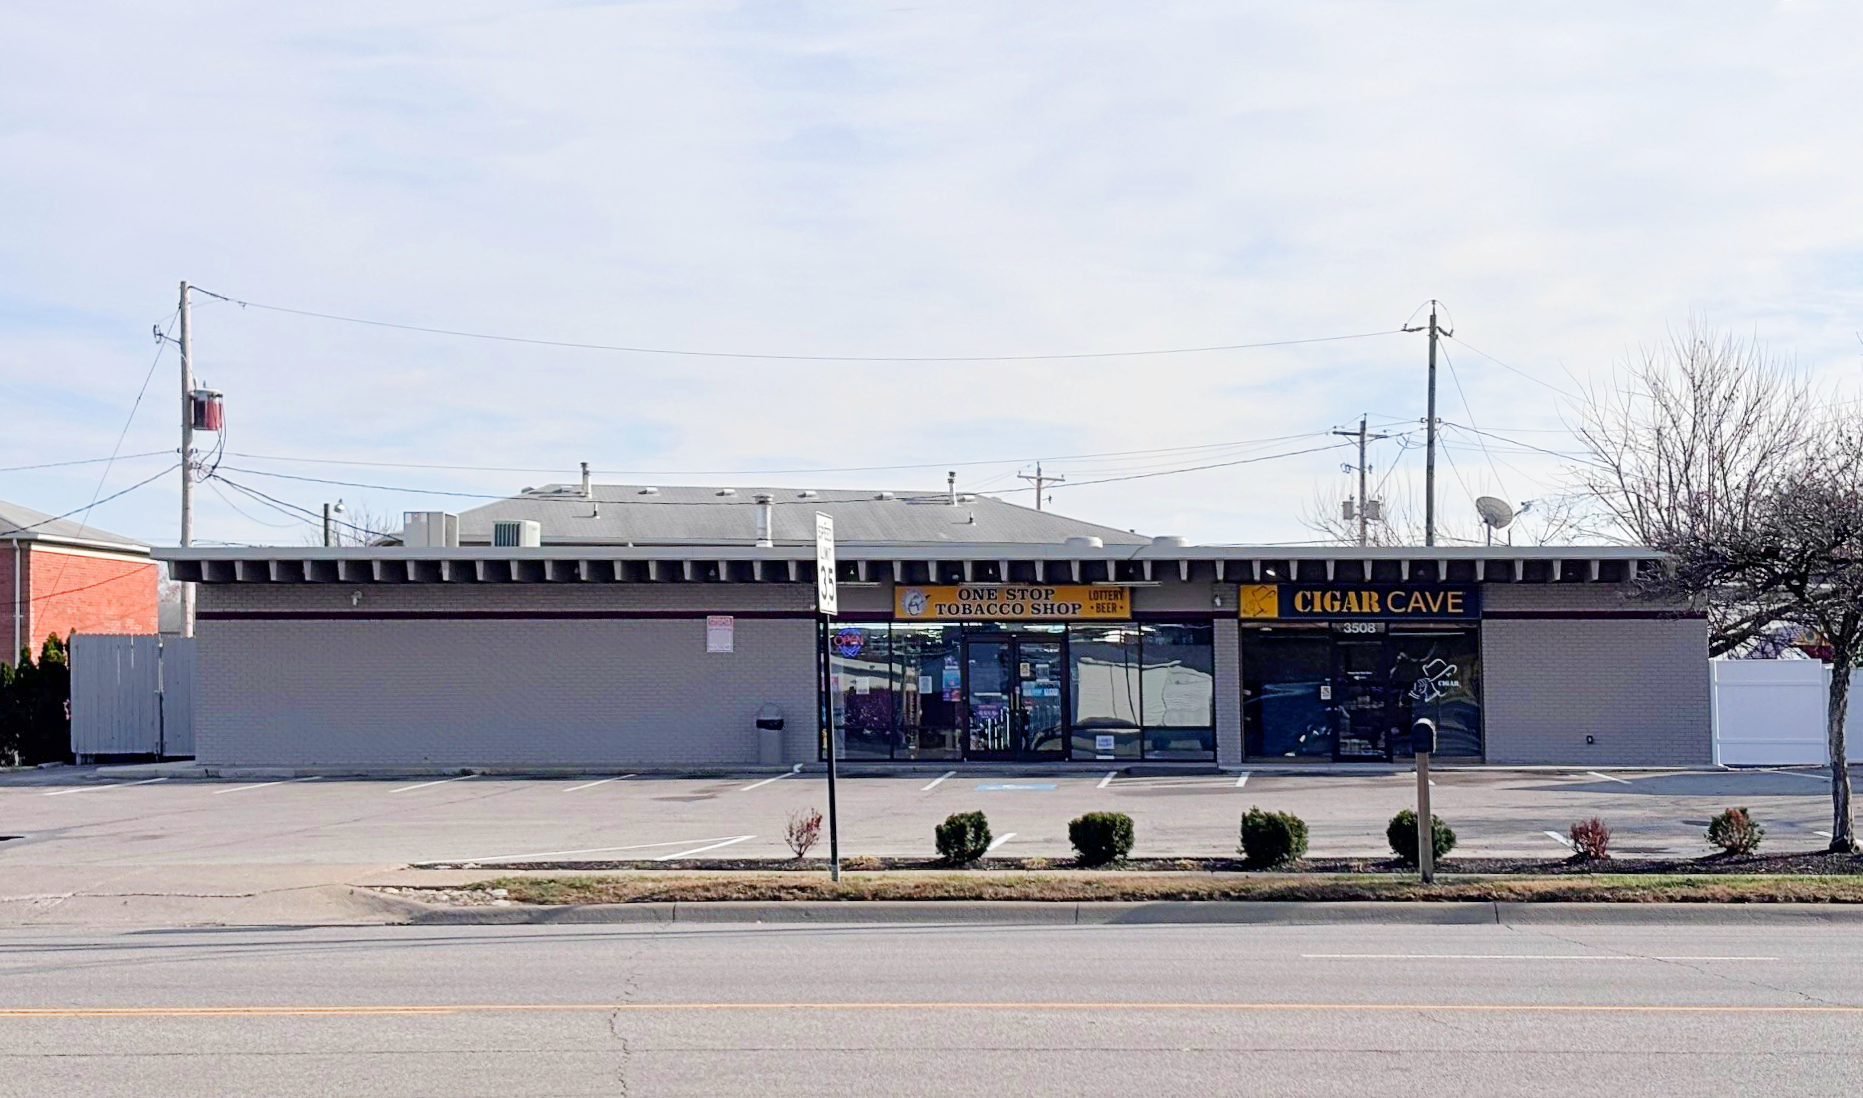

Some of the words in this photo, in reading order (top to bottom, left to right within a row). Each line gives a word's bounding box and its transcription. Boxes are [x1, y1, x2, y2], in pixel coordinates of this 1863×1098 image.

[821, 565, 835, 601] 35
[958, 588, 998, 600] ONE
[1006, 588, 1056, 600] STOP
[1088, 590, 1124, 600] LOTTERY
[1294, 590, 1381, 613] CIGAR
[1387, 591, 1464, 613] CAVE
[935, 603, 1025, 615] TOBACCO
[1031, 603, 1083, 615] SHOP
[1096, 603, 1117, 613] BEER
[1344, 622, 1376, 634] 3508
[833, 635, 864, 646] OPEN
